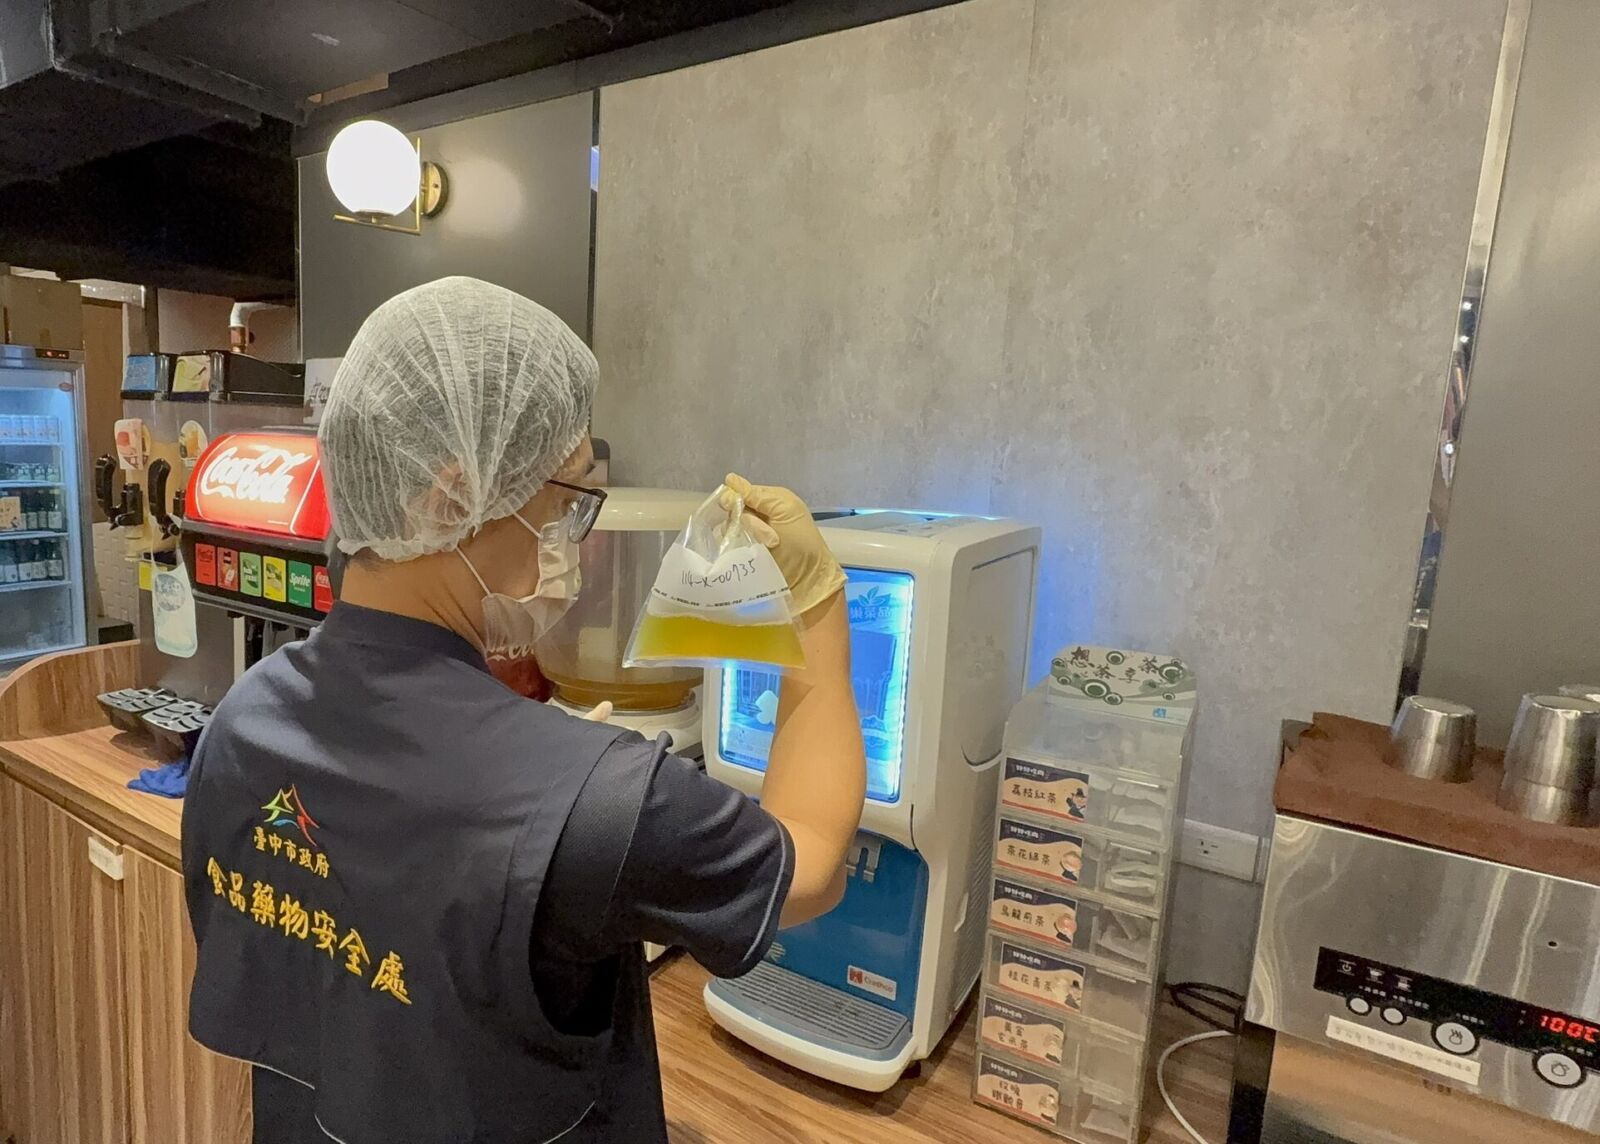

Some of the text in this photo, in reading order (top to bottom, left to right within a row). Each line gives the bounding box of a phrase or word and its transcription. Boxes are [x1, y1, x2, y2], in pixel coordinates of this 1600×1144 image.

[289, 572, 311, 587] Sprite
[254, 826, 330, 878] 臺中市政府
[207, 857, 412, 1005] 食品藥物安全處
